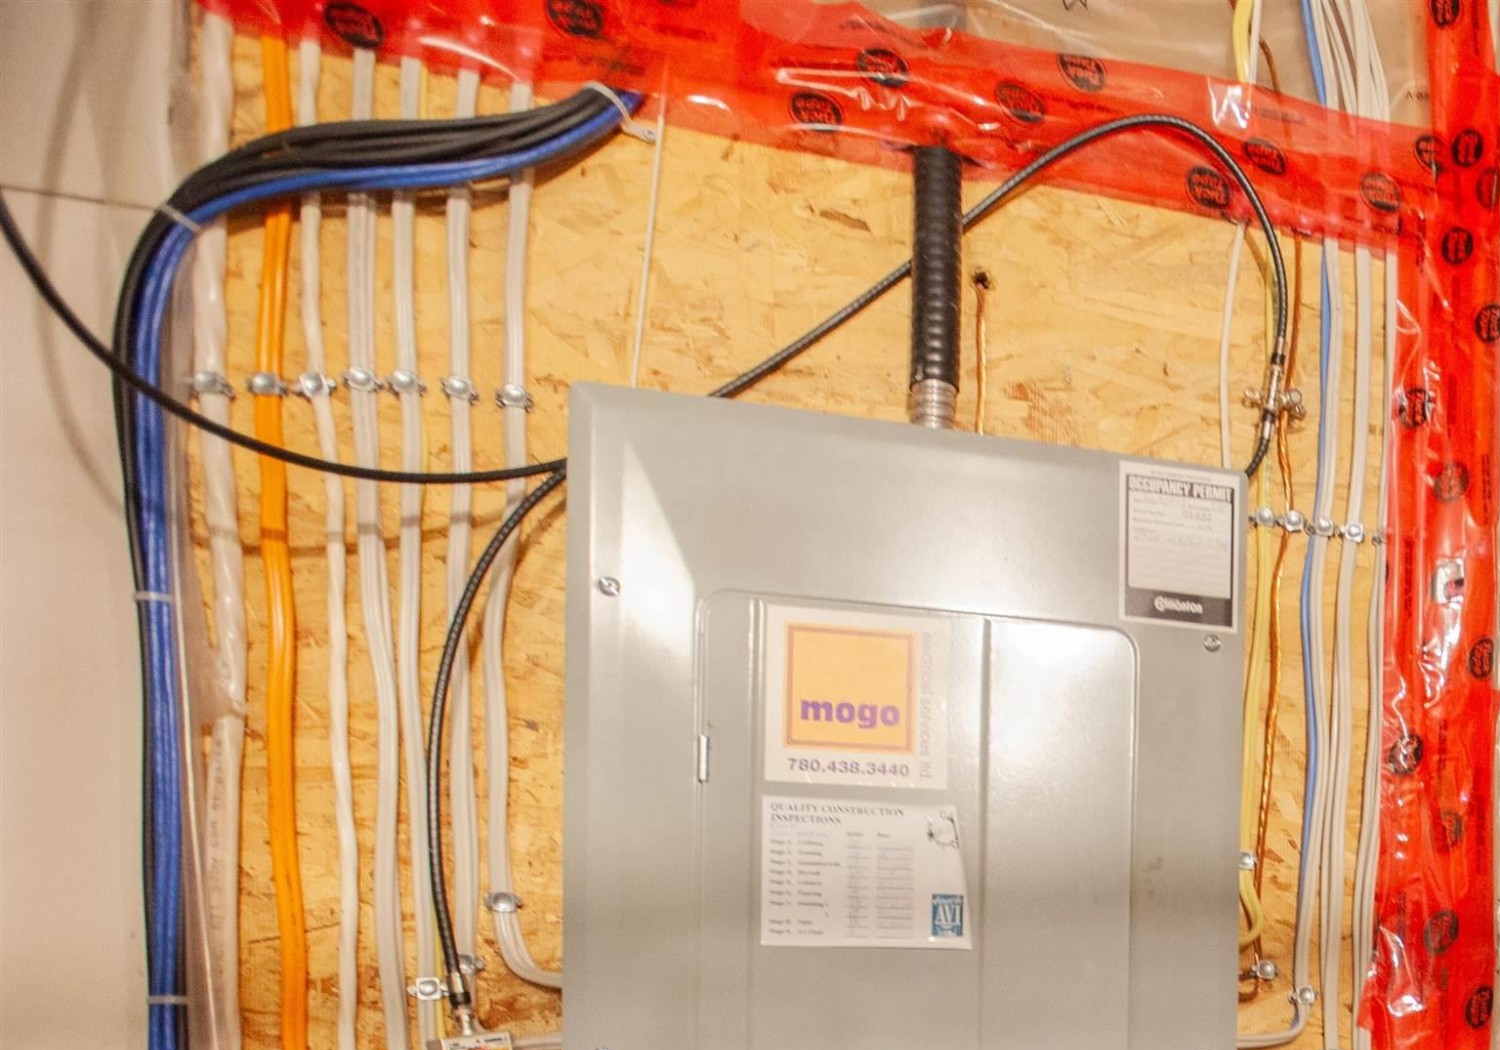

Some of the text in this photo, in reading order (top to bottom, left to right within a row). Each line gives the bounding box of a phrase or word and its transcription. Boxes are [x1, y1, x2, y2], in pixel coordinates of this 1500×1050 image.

[1130, 475, 1232, 502] OCCUPANCY PERMIT
[800, 698, 901, 729] mogo
[787, 757, 910, 777] 780.438.3440
[770, 803, 905, 817] QUALITY CONSTRUCTION
[770, 813, 842, 824] INSPECTIONS
